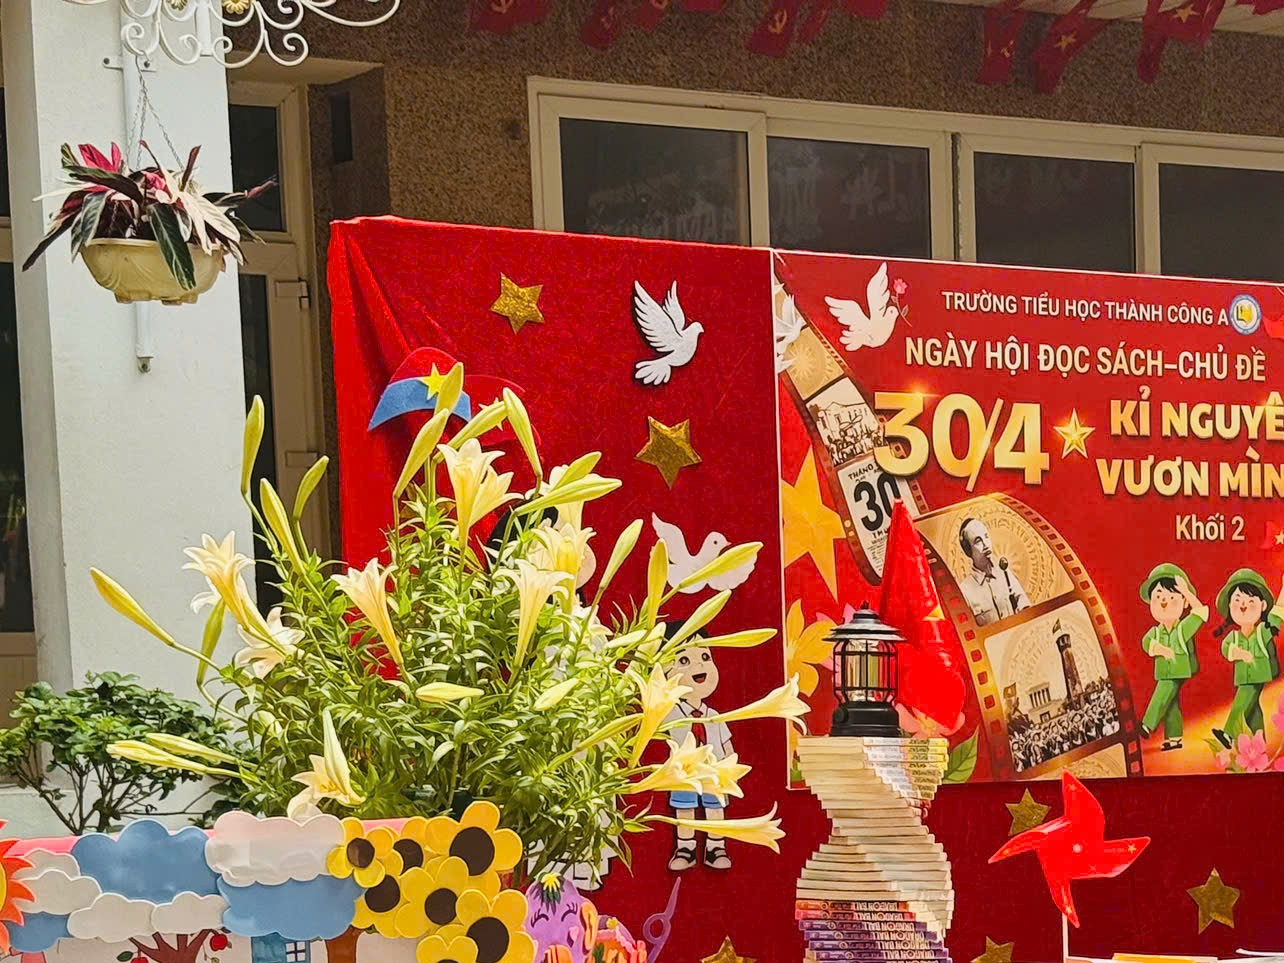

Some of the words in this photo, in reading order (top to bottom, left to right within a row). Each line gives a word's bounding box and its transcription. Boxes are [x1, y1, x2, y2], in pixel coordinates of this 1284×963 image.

[941, 288, 1018, 314] TRƯỜNG
[1020, 291, 1060, 316] TIỂU
[1064, 298, 1100, 322] HỌC
[1104, 298, 1163, 322] THÀNH
[1167, 301, 1213, 325] CÔNG
[1217, 305, 1229, 326] A
[905, 331, 977, 368] NGÀY
[985, 335, 1029, 376] HỘI
[1037, 343, 1090, 378] ĐỌC
[1235, 346, 1266, 382] ĐỀ
[1109, 385, 1151, 437] KỈ
[873, 391, 1050, 492] 30/4
[1095, 455, 1210, 497] VƯƠN
[853, 473, 902, 532] 30
[1175, 513, 1225, 541] Khối
[1231, 516, 1246, 541] 2
